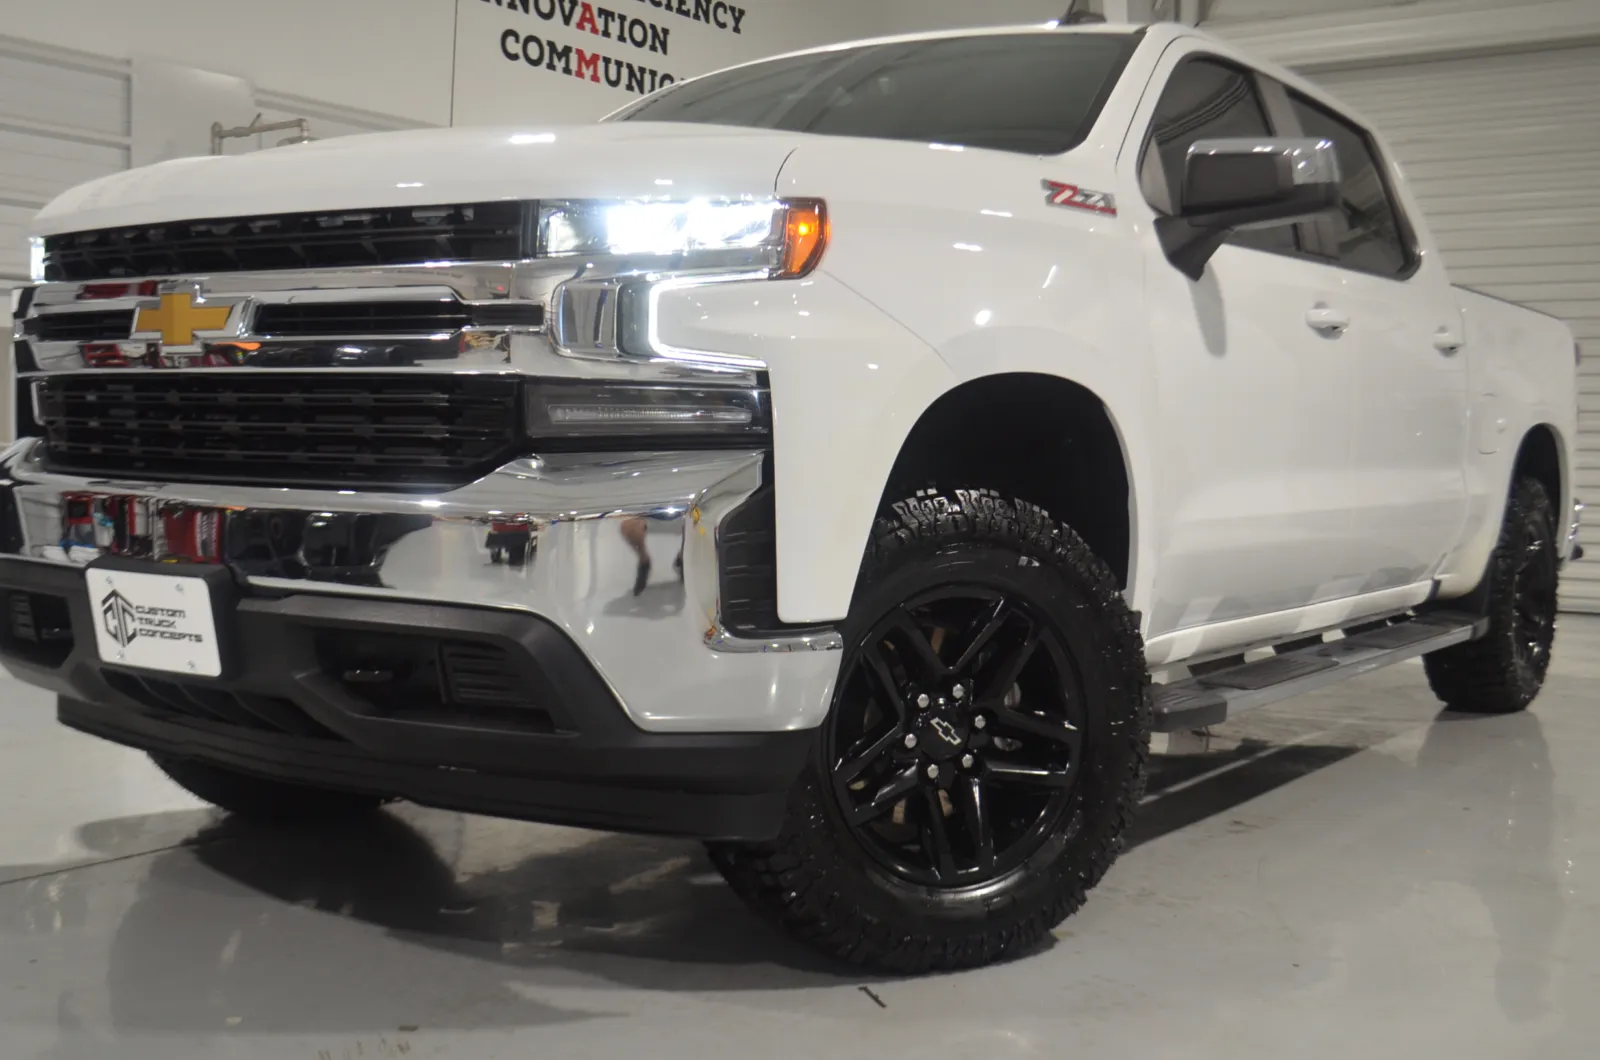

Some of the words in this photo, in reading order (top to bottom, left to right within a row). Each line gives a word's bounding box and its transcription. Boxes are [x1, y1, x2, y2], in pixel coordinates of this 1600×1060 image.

[482, 0, 670, 55] OVATION
[637, 0, 746, 34] ENCY
[500, 29, 676, 94] COMMUNI
[135, 605, 186, 619] CUSTOM
[136, 616, 177, 629] TRUCK
[139, 628, 203, 642] CONCEPTS
